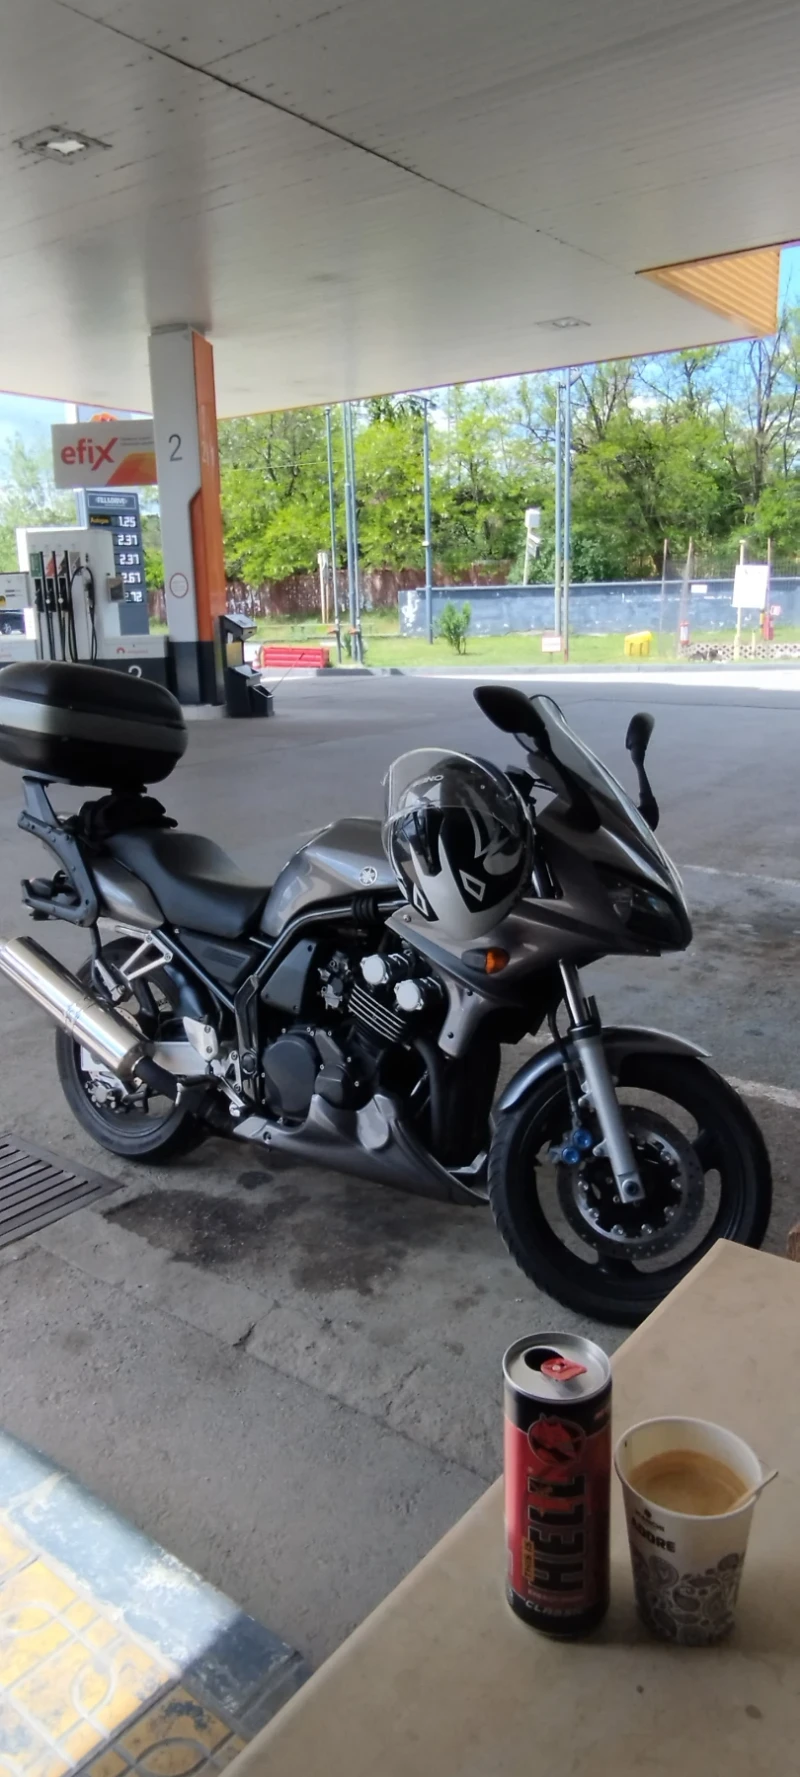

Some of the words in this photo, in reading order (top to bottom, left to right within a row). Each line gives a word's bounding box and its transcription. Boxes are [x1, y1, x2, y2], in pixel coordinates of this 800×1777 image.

[60, 437, 119, 472] efix
[168, 433, 183, 462] 2
[527, 1474, 585, 1591] HELL
